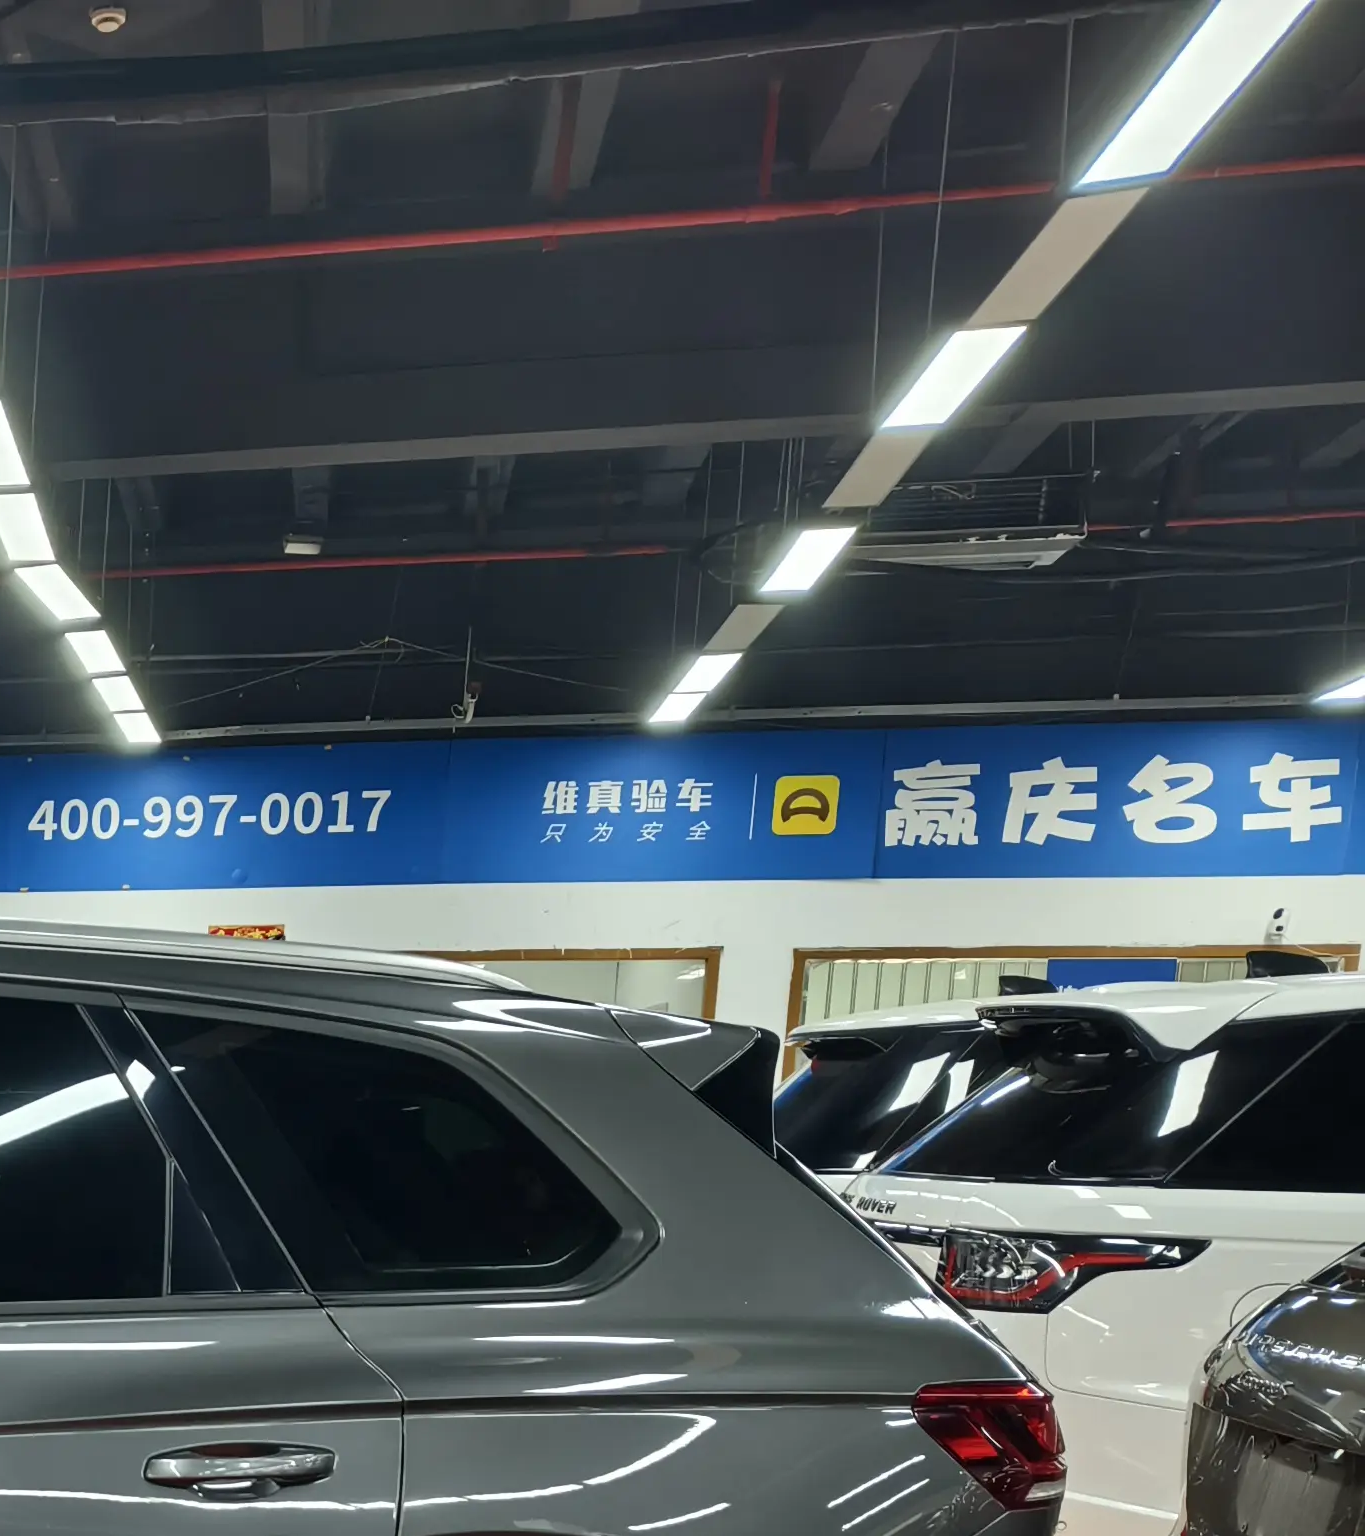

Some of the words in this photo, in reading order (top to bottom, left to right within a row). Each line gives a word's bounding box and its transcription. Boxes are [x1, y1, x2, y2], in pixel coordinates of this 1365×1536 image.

[542, 779, 713, 814] 维真验车
[885, 753, 1343, 846] 赢庆名车
[28, 790, 392, 840] 400-997-0017
[540, 820, 711, 843] 只为安全
[855, 1196, 897, 1215] ROVER
